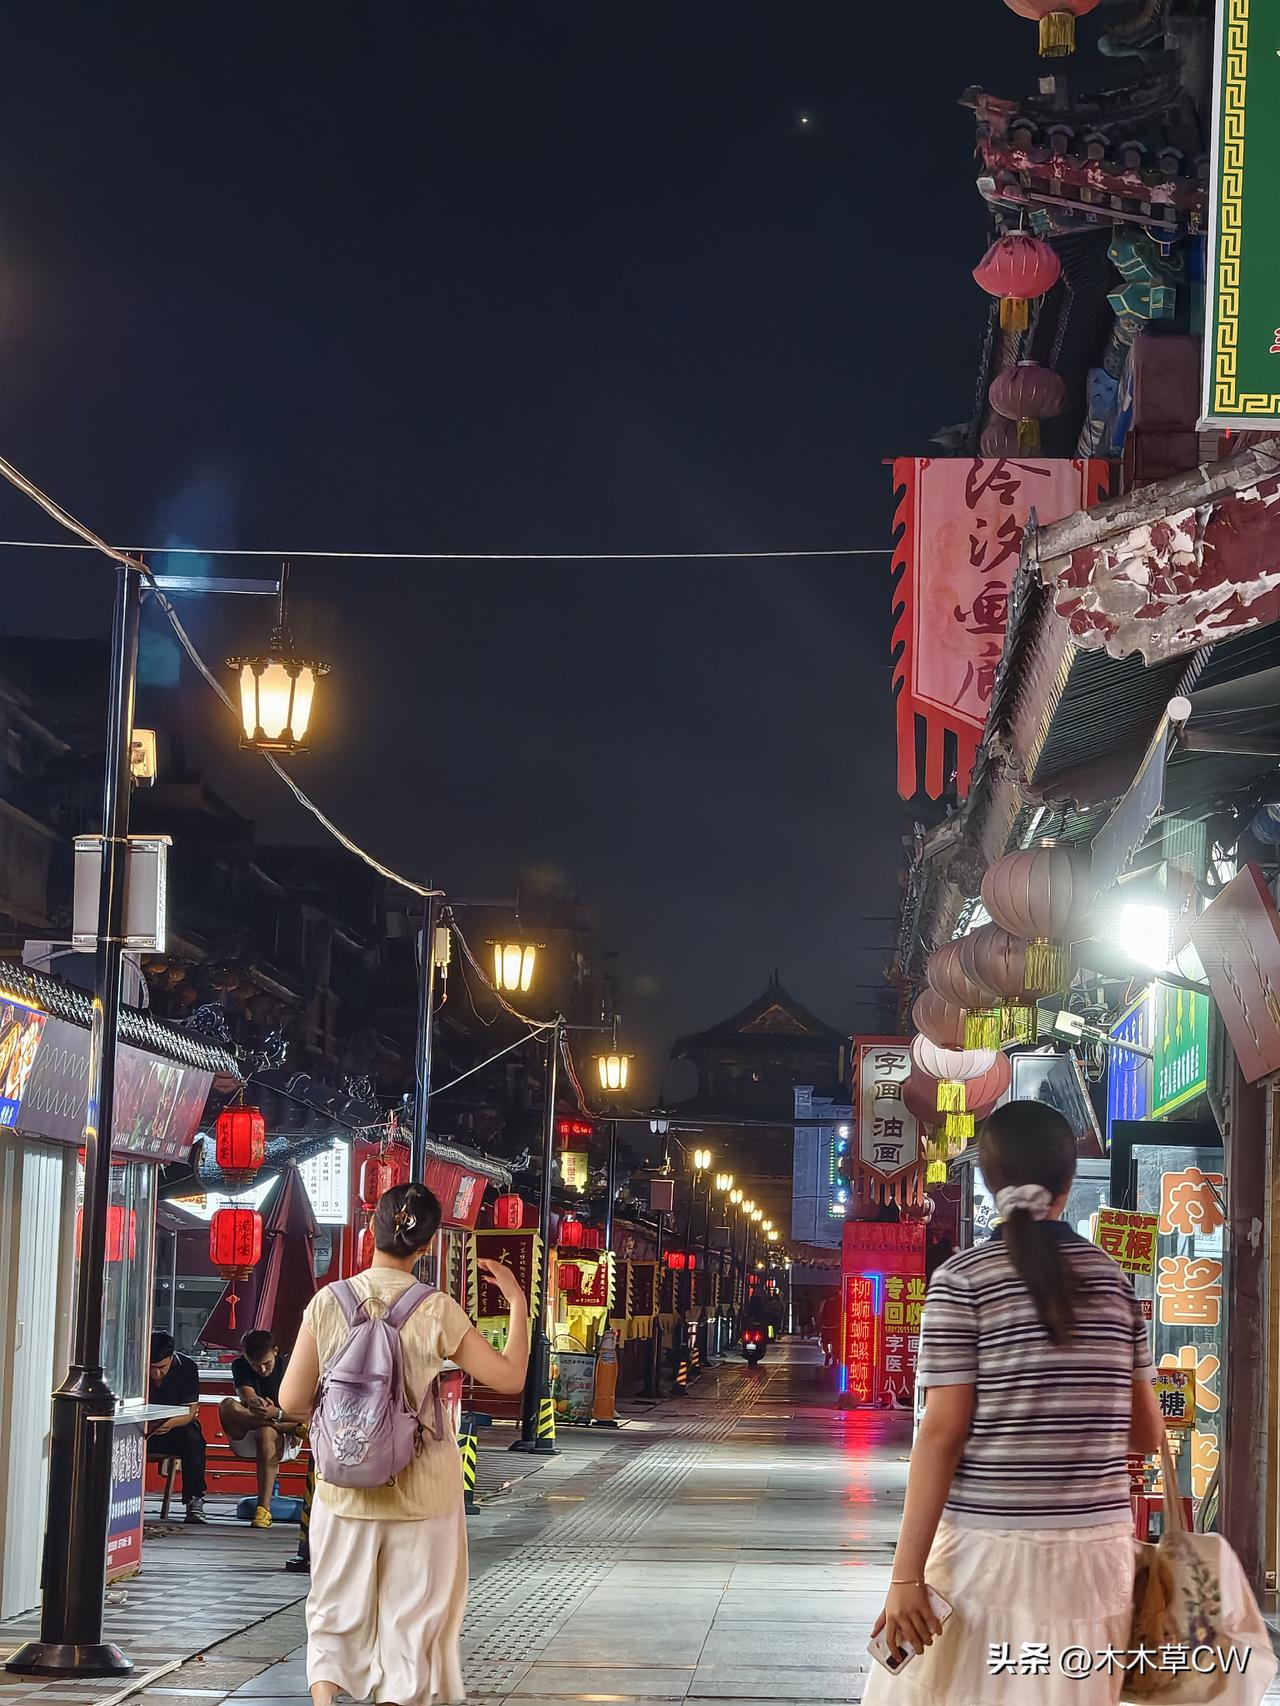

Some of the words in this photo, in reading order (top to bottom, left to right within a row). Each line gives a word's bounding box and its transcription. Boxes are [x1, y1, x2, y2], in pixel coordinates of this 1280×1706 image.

[873, 1051, 906, 1164] 字画油画
[1099, 1211, 1158, 1231] 天津特产
[1099, 1227, 1152, 1261] 豆根
[885, 1276, 927, 1300] 专业
[1159, 1390, 1186, 1417] 糖
